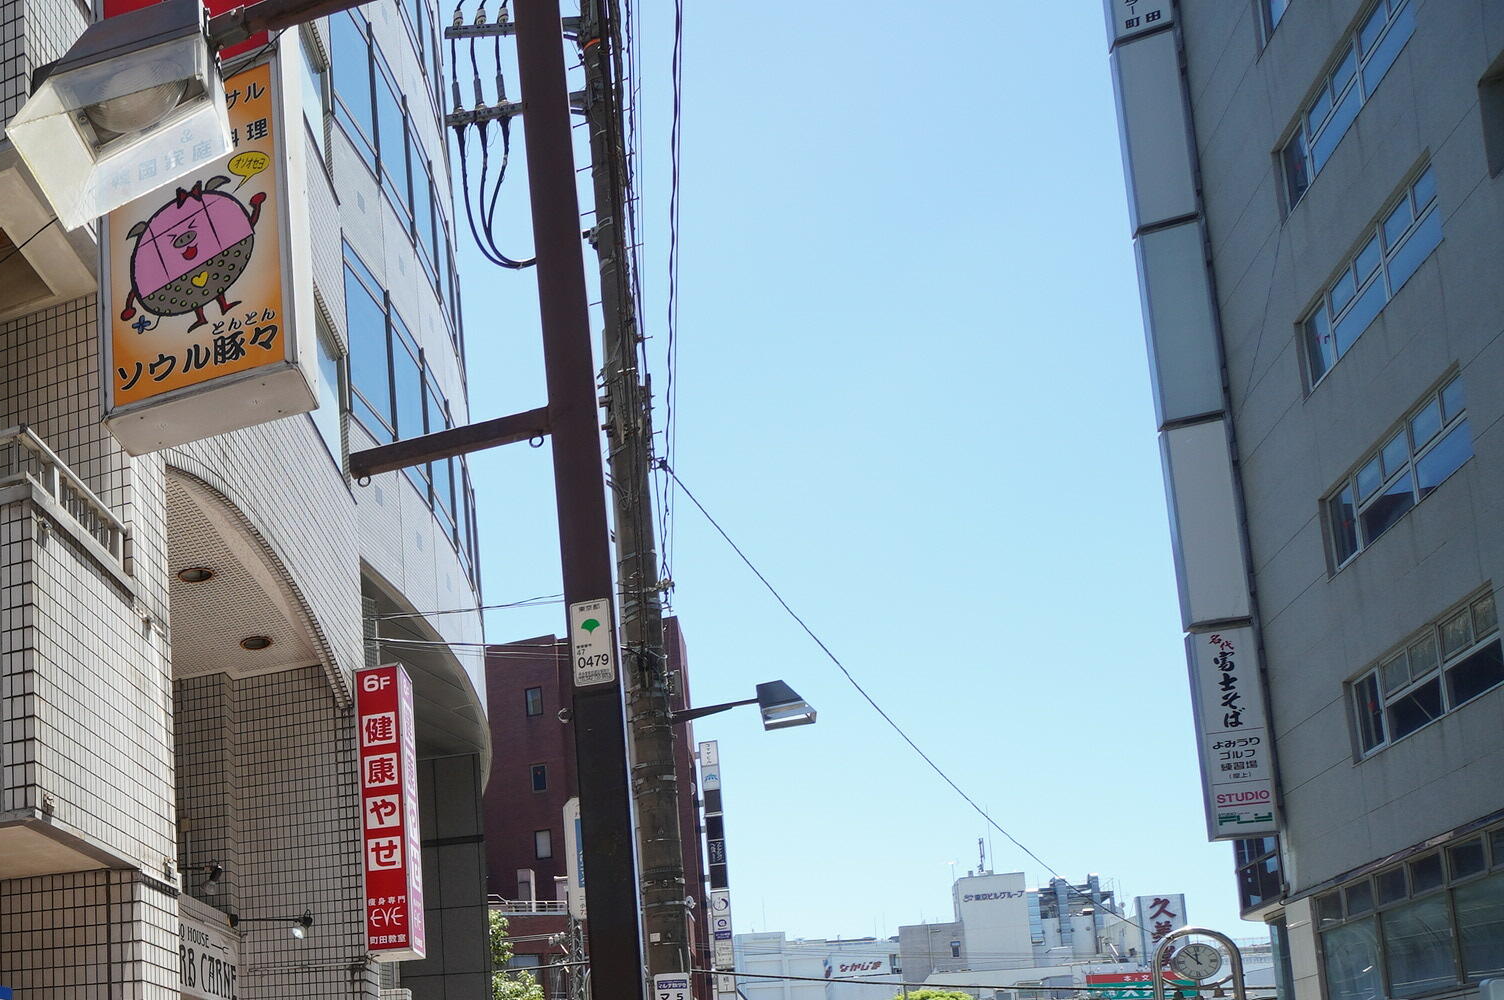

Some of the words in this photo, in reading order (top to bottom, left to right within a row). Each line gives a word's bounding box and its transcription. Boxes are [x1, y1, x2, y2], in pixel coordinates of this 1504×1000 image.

[1125, 10, 1161, 29] 町田
[212, 307, 275, 335] とんとん
[118, 324, 279, 391] ソウル豚々
[577, 653, 609, 669] 0479
[362, 674, 390, 694] 6F
[1213, 651, 1245, 728] 富士そば
[1212, 736, 1261, 750] よみうり
[1219, 750, 1256, 760] ゴルフ
[1221, 761, 1258, 772] 練習場
[364, 716, 402, 869] 健康やせ
[1216, 789, 1271, 804] STUDIO
[188, 926, 210, 949] HOUSE
[369, 933, 408, 945] 町田教室
